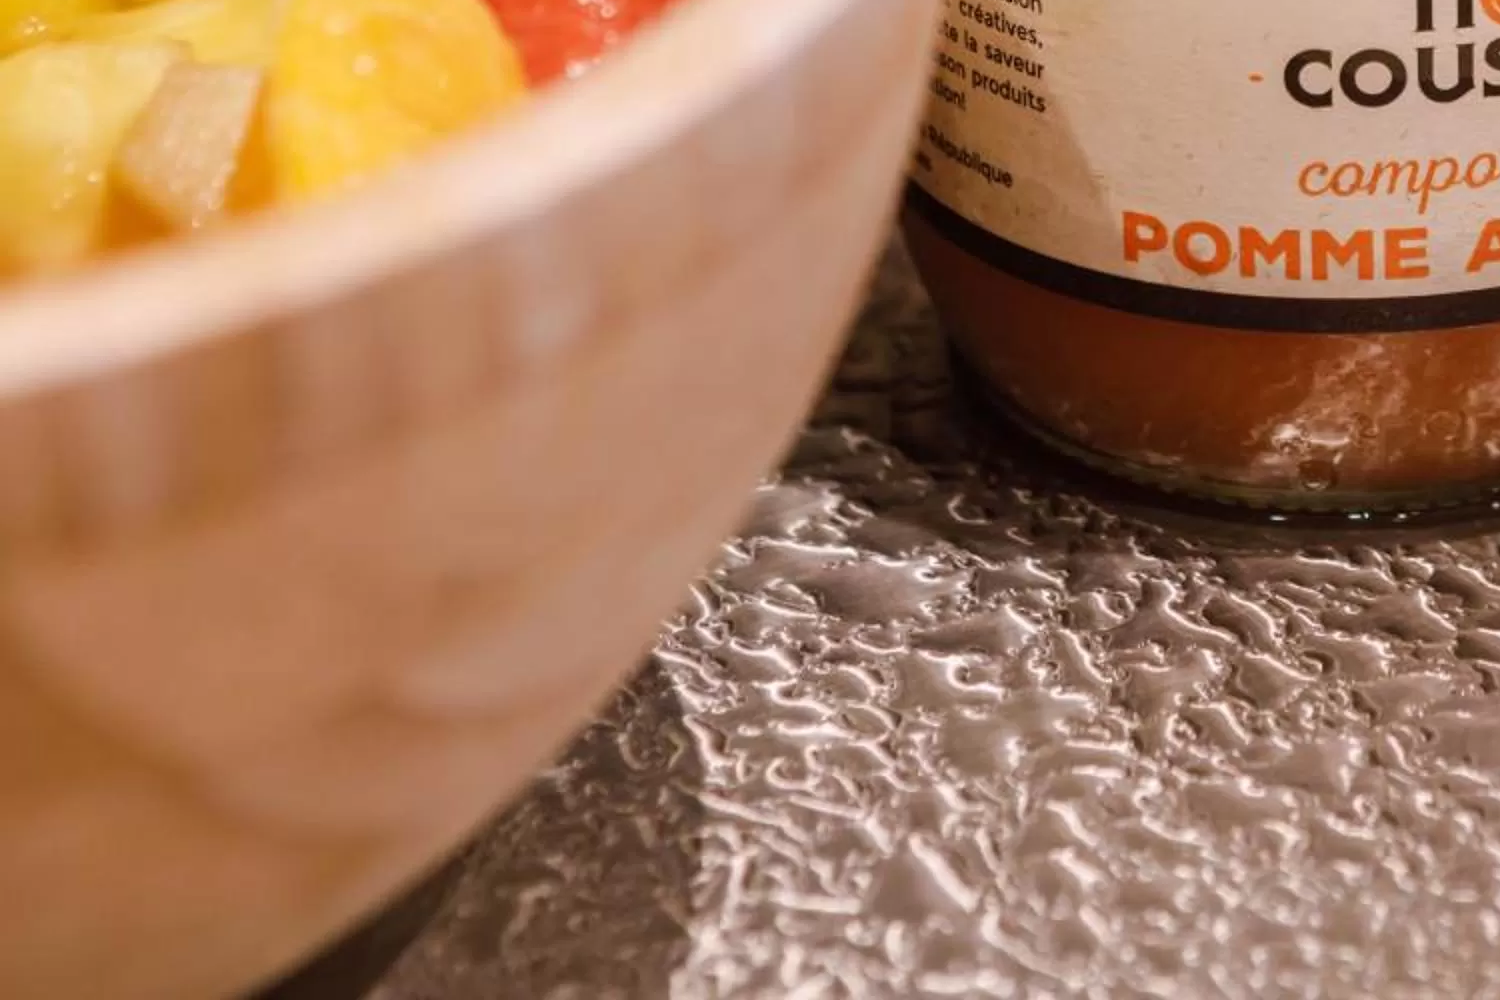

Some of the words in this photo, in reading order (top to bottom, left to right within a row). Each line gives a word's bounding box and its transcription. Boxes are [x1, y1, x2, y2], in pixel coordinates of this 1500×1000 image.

[963, 29, 978, 53] la
[984, 43, 1045, 79] saveur
[972, 69, 1046, 112] produits
[1122, 211, 1430, 281] POMME
